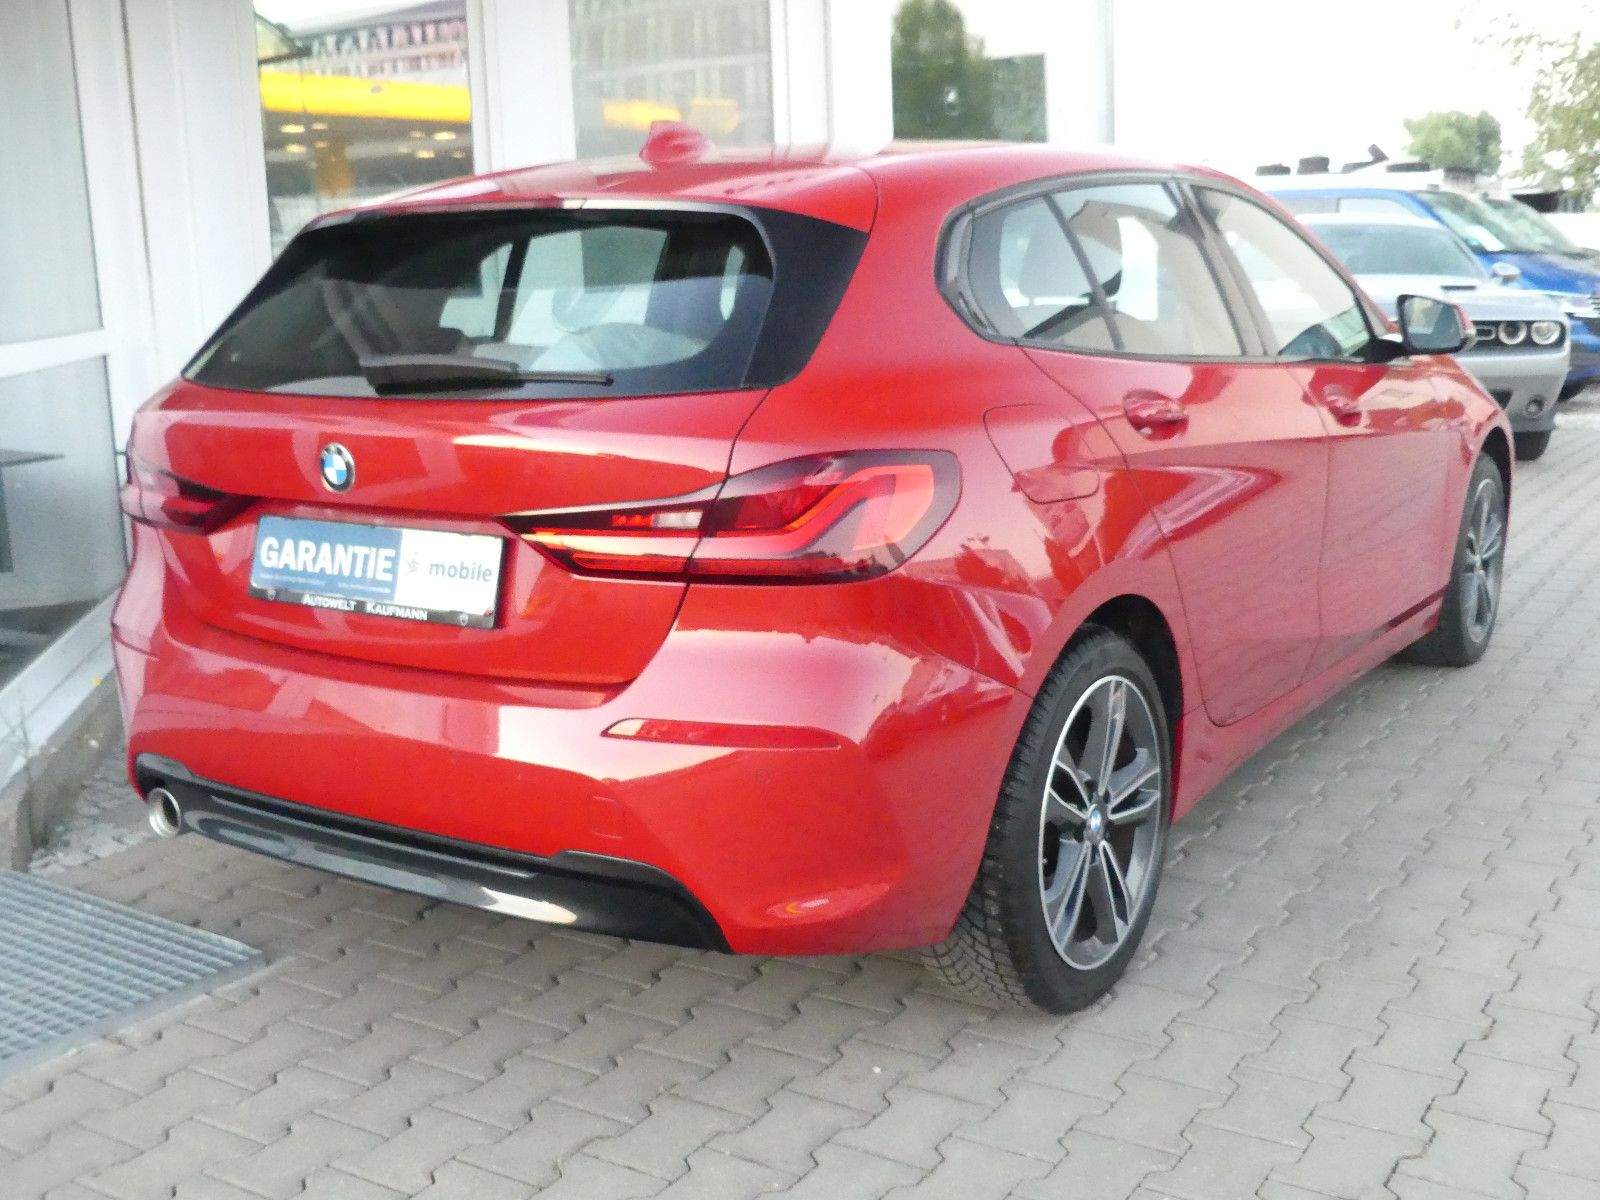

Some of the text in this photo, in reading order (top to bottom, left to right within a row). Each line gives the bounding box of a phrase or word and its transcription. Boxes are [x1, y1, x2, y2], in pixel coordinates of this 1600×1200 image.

[260, 536, 396, 581] GARANTIE
[429, 560, 493, 582] mobile
[366, 600, 428, 621] KAUFMANN
